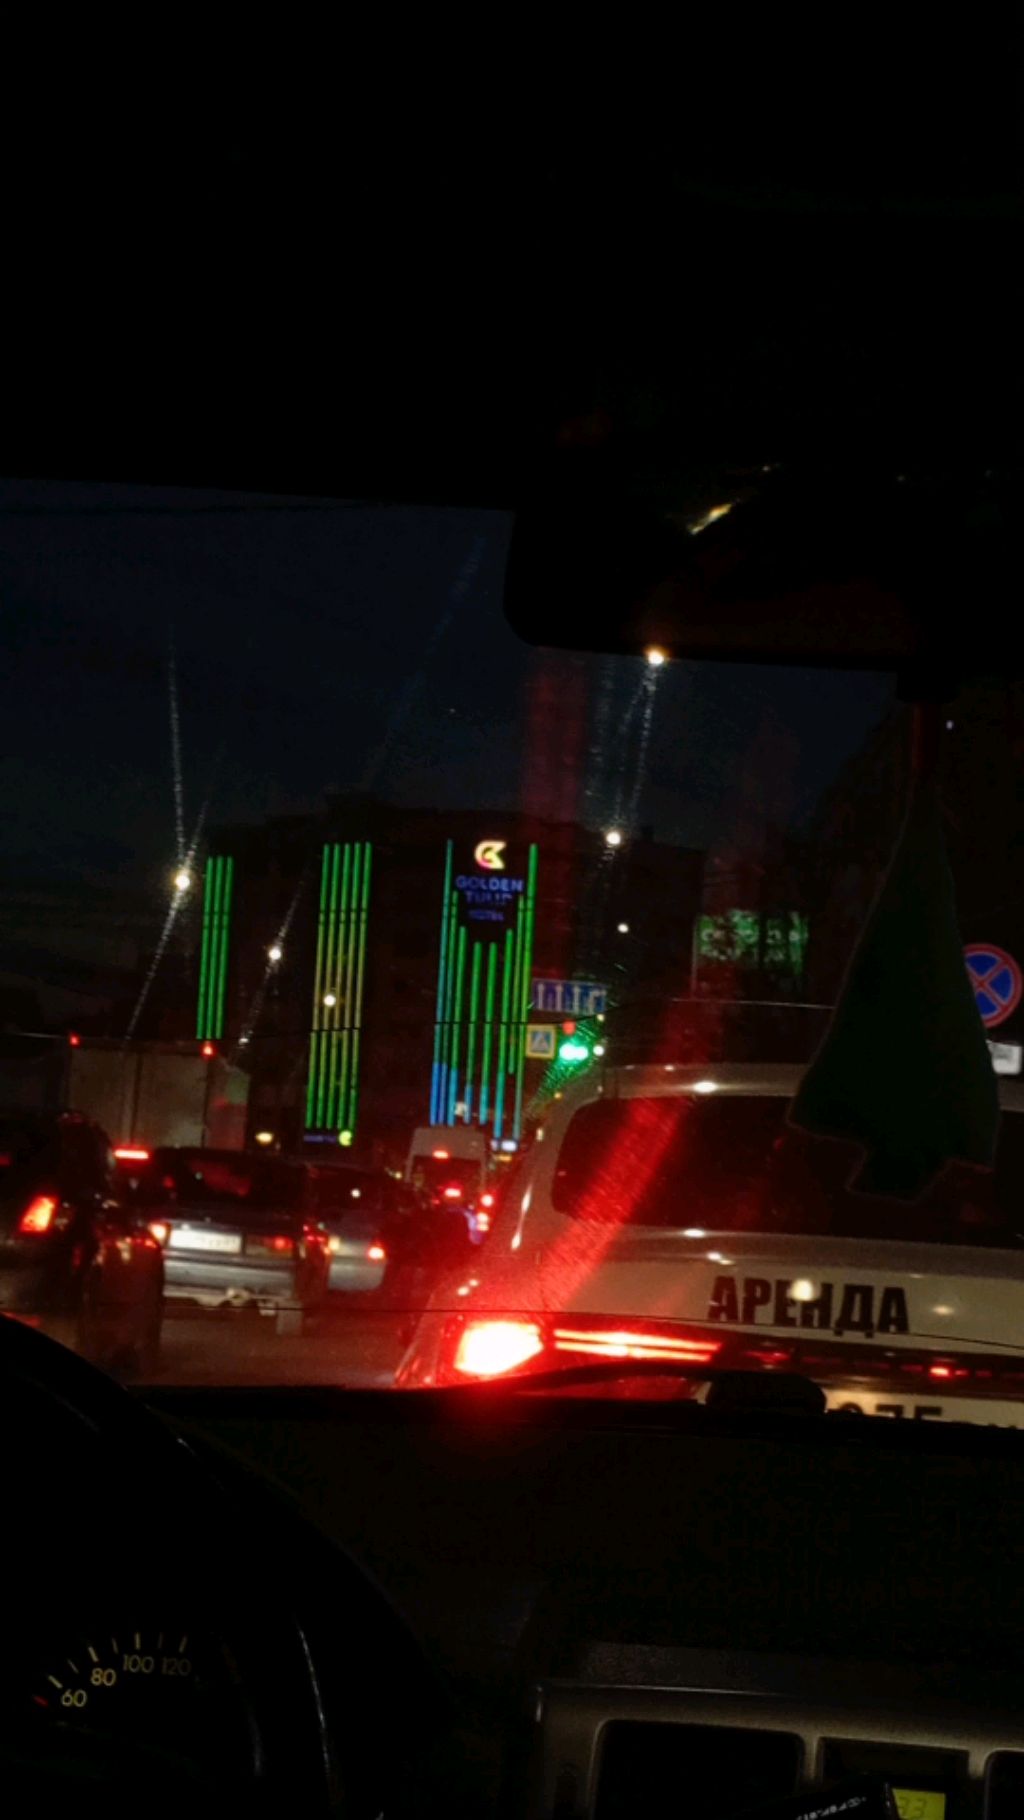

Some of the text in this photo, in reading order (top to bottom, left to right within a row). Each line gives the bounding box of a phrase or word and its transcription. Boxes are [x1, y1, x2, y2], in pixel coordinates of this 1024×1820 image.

[455, 875, 524, 892] GOLDEN
[708, 1275, 909, 1337] АРЕНДА
[122, 1654, 155, 1675] 100
[161, 1656, 192, 1677] 120
[90, 1667, 117, 1687] 80
[60, 1688, 88, 1708] 60
